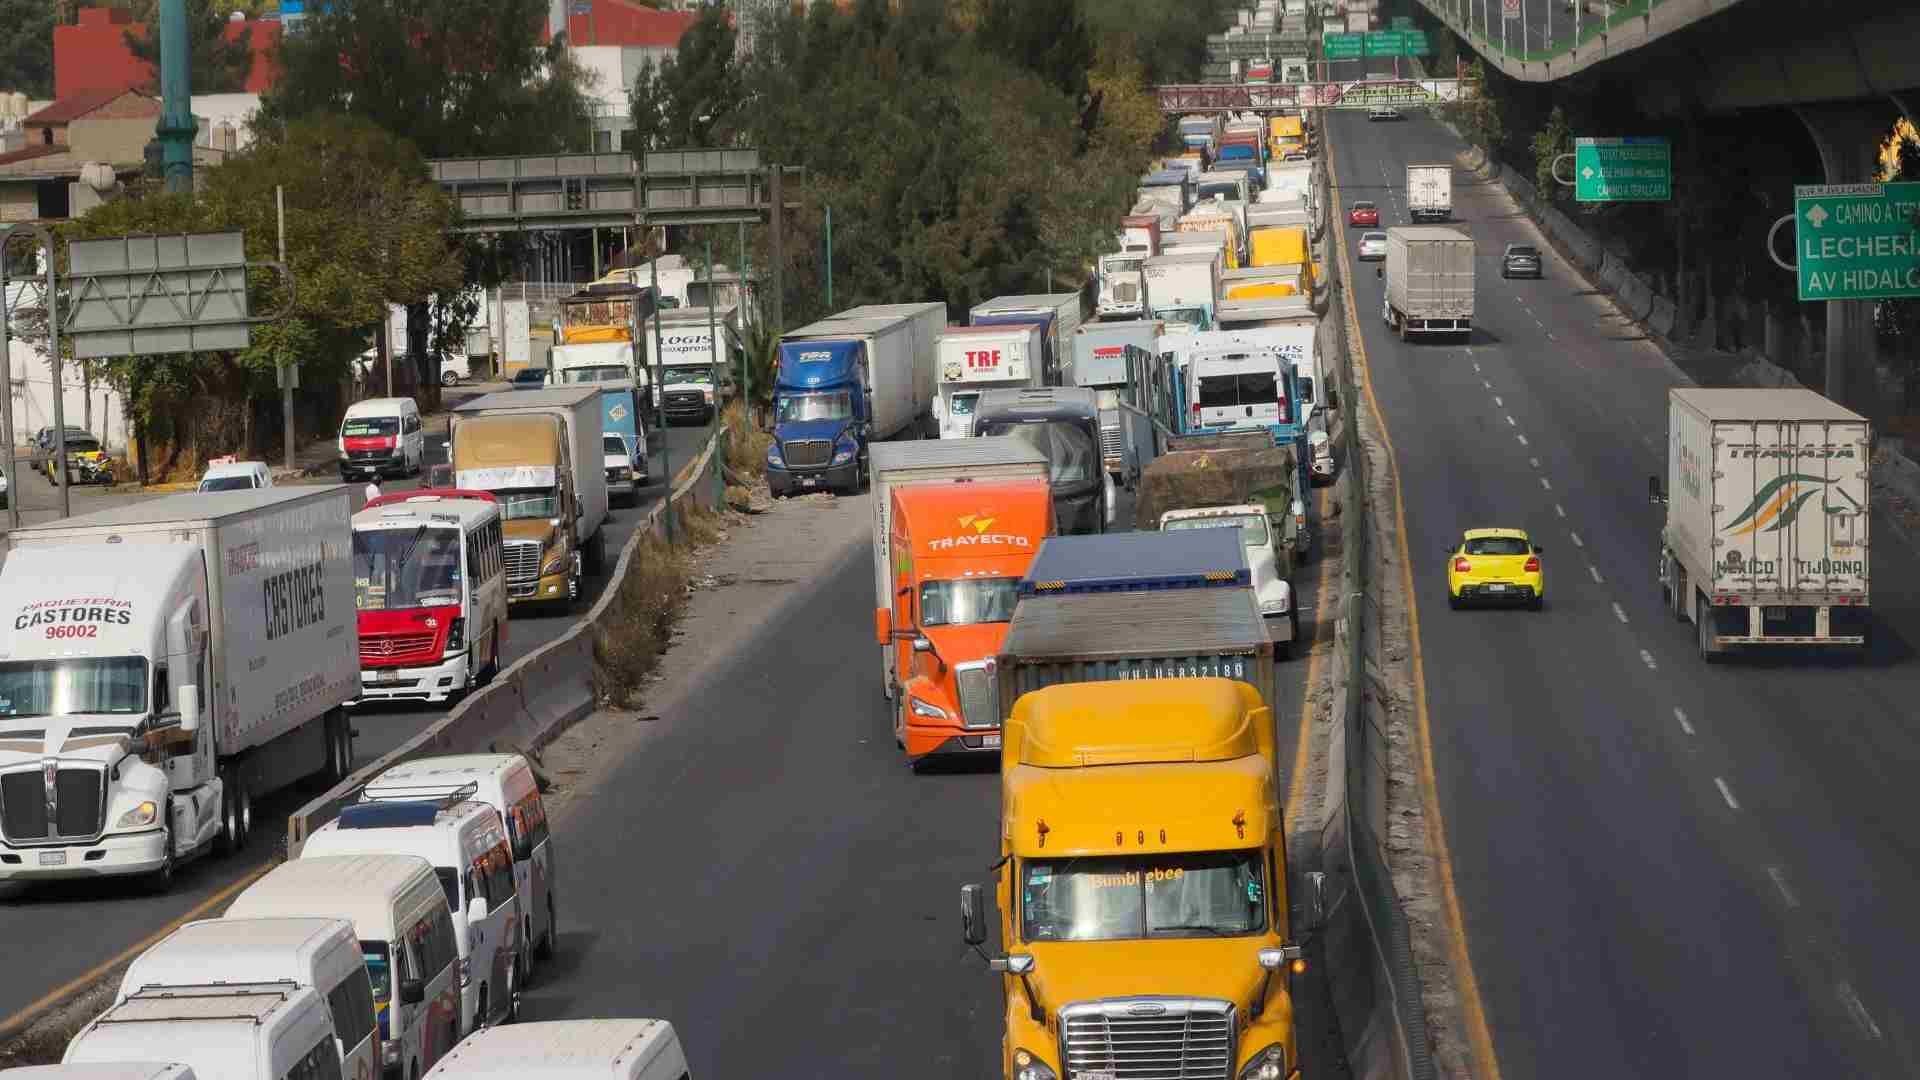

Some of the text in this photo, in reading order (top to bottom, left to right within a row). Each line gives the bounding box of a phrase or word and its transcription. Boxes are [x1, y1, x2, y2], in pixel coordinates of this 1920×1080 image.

[1836, 203, 1881, 225] CAMINO
[1884, 203, 1894, 223] A
[1806, 230, 1920, 259] LECHERÍ
[1809, 271, 1837, 292] AV
[965, 350, 1001, 368] TRF
[928, 534, 1029, 551] TRAYECTO
[1799, 560, 1863, 574] TIJUANA
[263, 561, 326, 640] CASTORES
[15, 607, 132, 630] CASTORES
[46, 625, 98, 639] 96002
